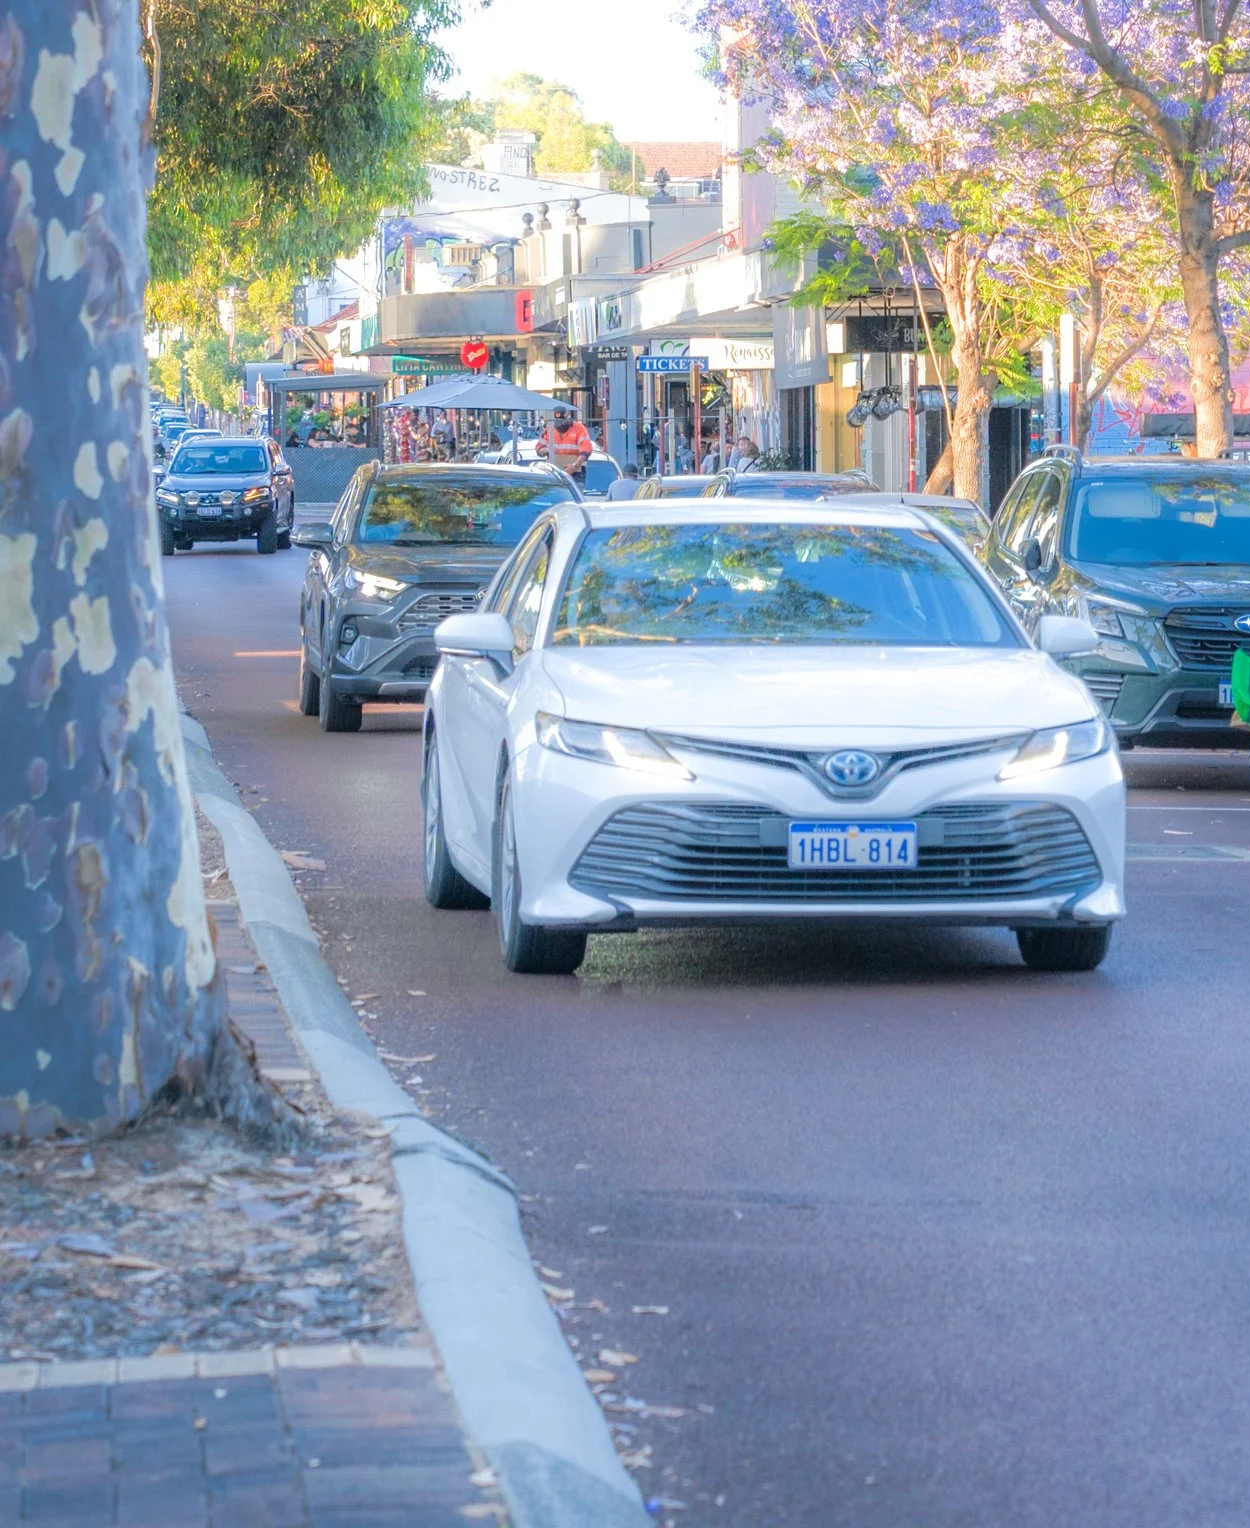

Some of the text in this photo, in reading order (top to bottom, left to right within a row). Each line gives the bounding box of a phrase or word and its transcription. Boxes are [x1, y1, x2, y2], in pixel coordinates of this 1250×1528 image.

[642, 358, 706, 371] TICKETS
[798, 837, 909, 863] 1HBL 814
